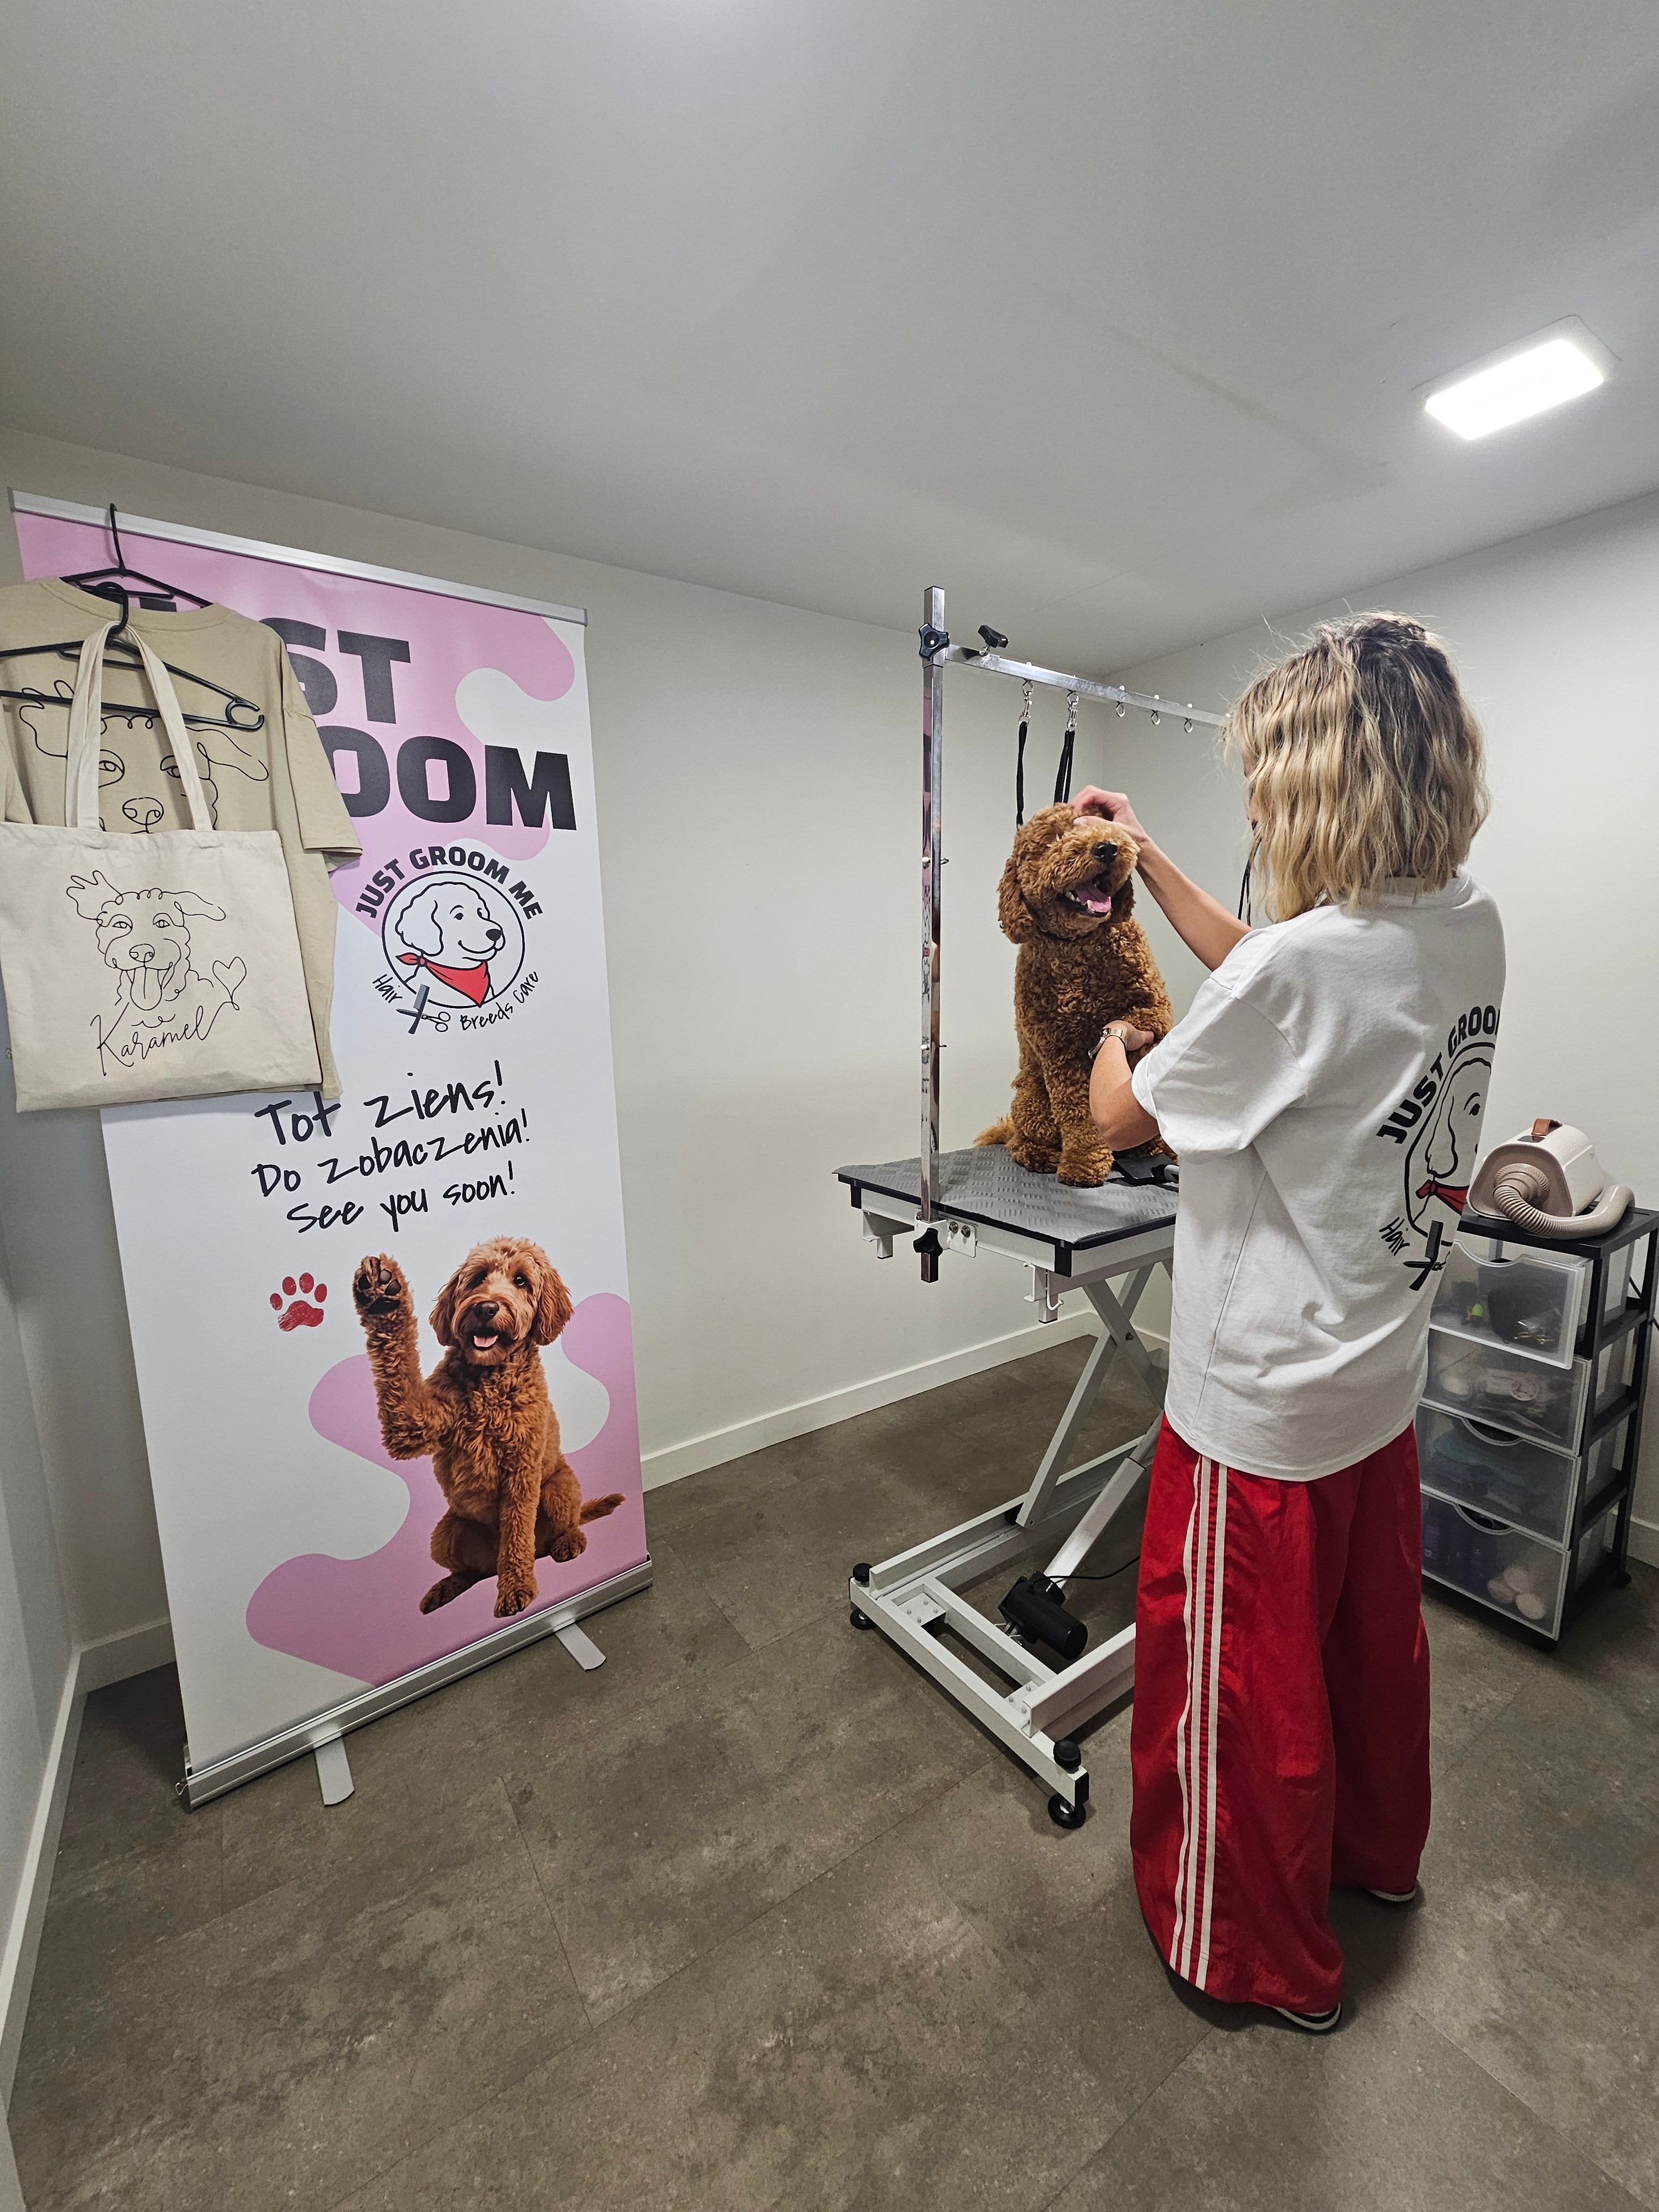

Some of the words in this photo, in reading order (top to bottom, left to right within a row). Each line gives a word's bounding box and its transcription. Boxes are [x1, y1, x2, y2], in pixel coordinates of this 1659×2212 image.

[258, 617, 411, 724] ST
[317, 725, 577, 830] OOM
[356, 858, 405, 919] JUST
[409, 846, 510, 885] GROOM
[508, 880, 543, 920] ME
[90, 1002, 218, 1076] Karamel
[372, 974, 403, 1003] Hair
[460, 1002, 513, 1030] Breeds
[1375, 1051, 1443, 1144] JUST
[1448, 1005, 1500, 1058] GROO
[251, 1164, 300, 1197] Do
[317, 1108, 530, 1183] zobaczenia!
[254, 1092, 341, 1145] Tot
[380, 1188, 428, 1232] you
[443, 1160, 515, 1206] soon!
[1379, 1217, 1410, 1256] Hair
